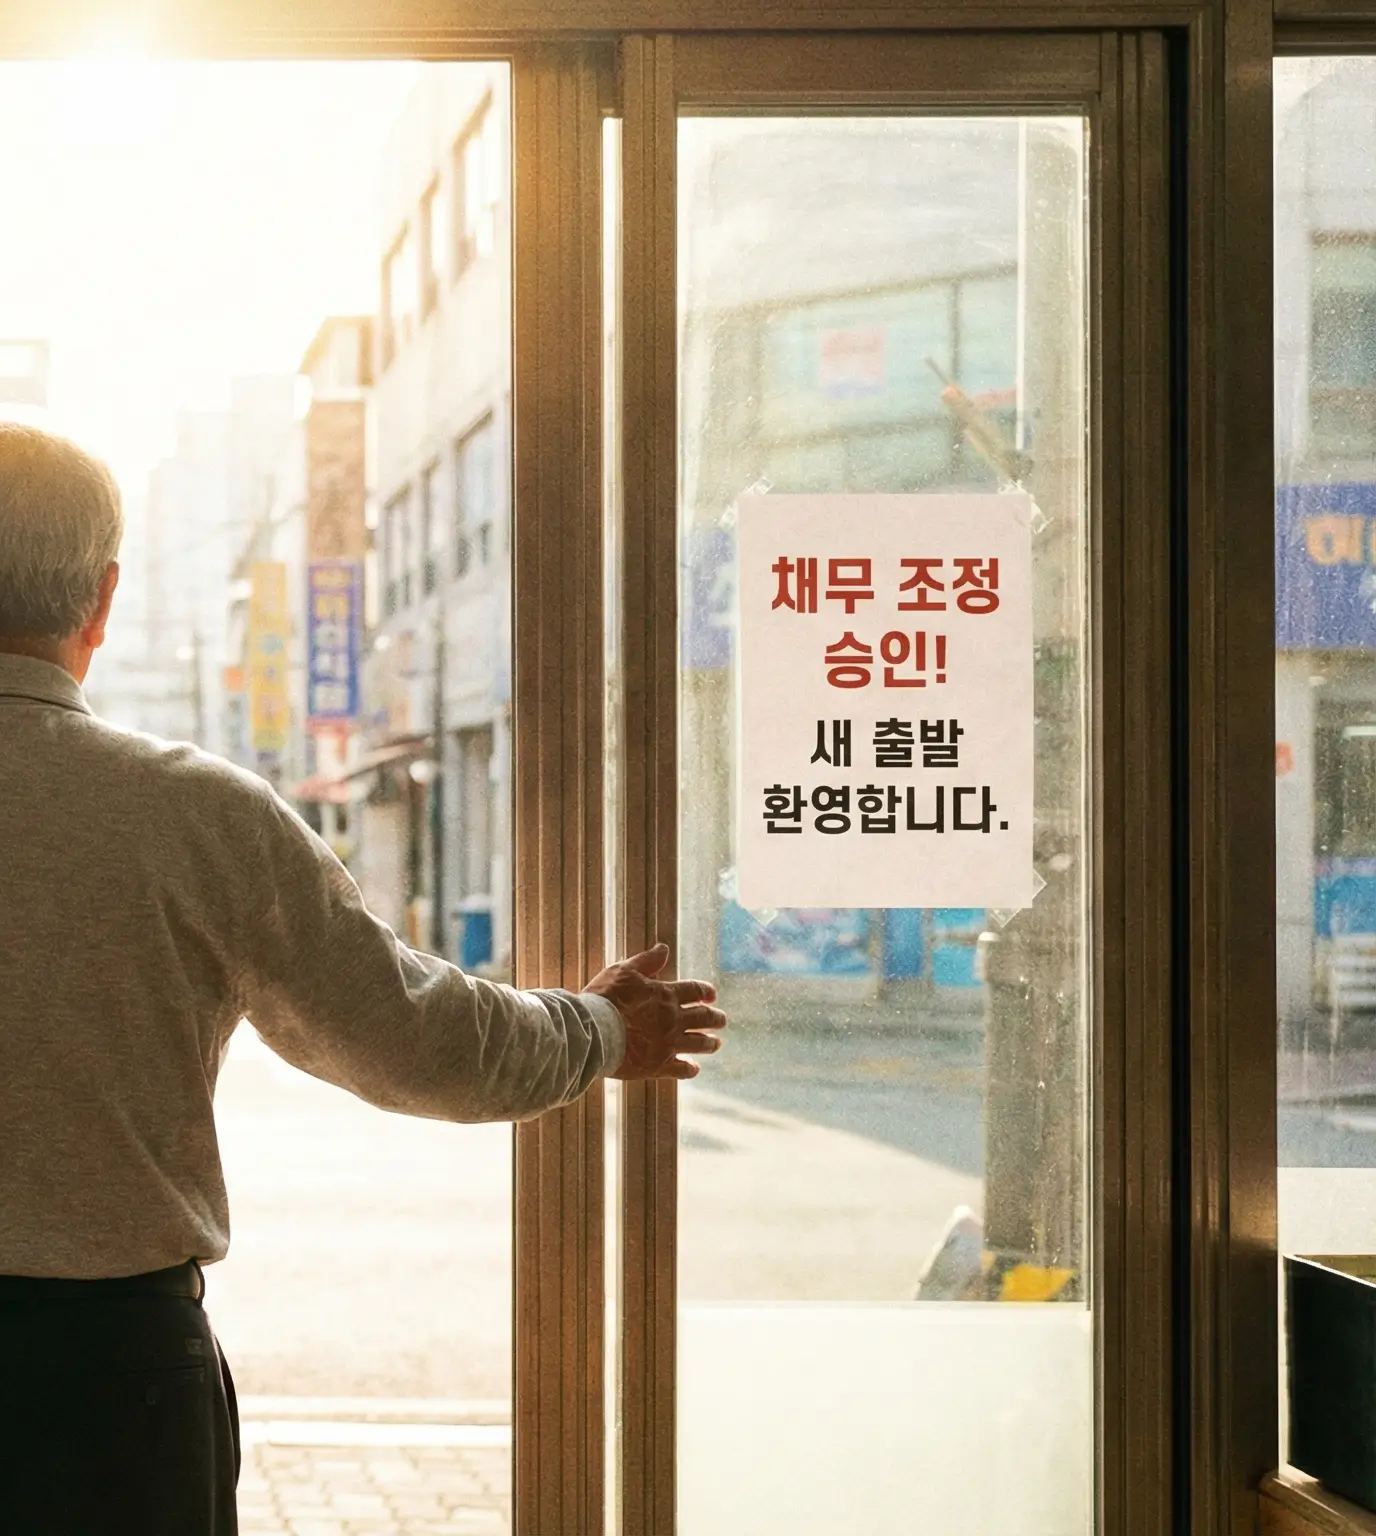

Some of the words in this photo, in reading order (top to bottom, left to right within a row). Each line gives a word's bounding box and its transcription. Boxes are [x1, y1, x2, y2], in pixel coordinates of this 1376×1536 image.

[770, 556, 875, 615] 채무
[897, 557, 1001, 615] 조정
[823, 630, 948, 690] 승인!
[810, 718, 853, 768] 새
[872, 717, 965, 769] 출발
[761, 783, 1010, 835] 환영합니다.
